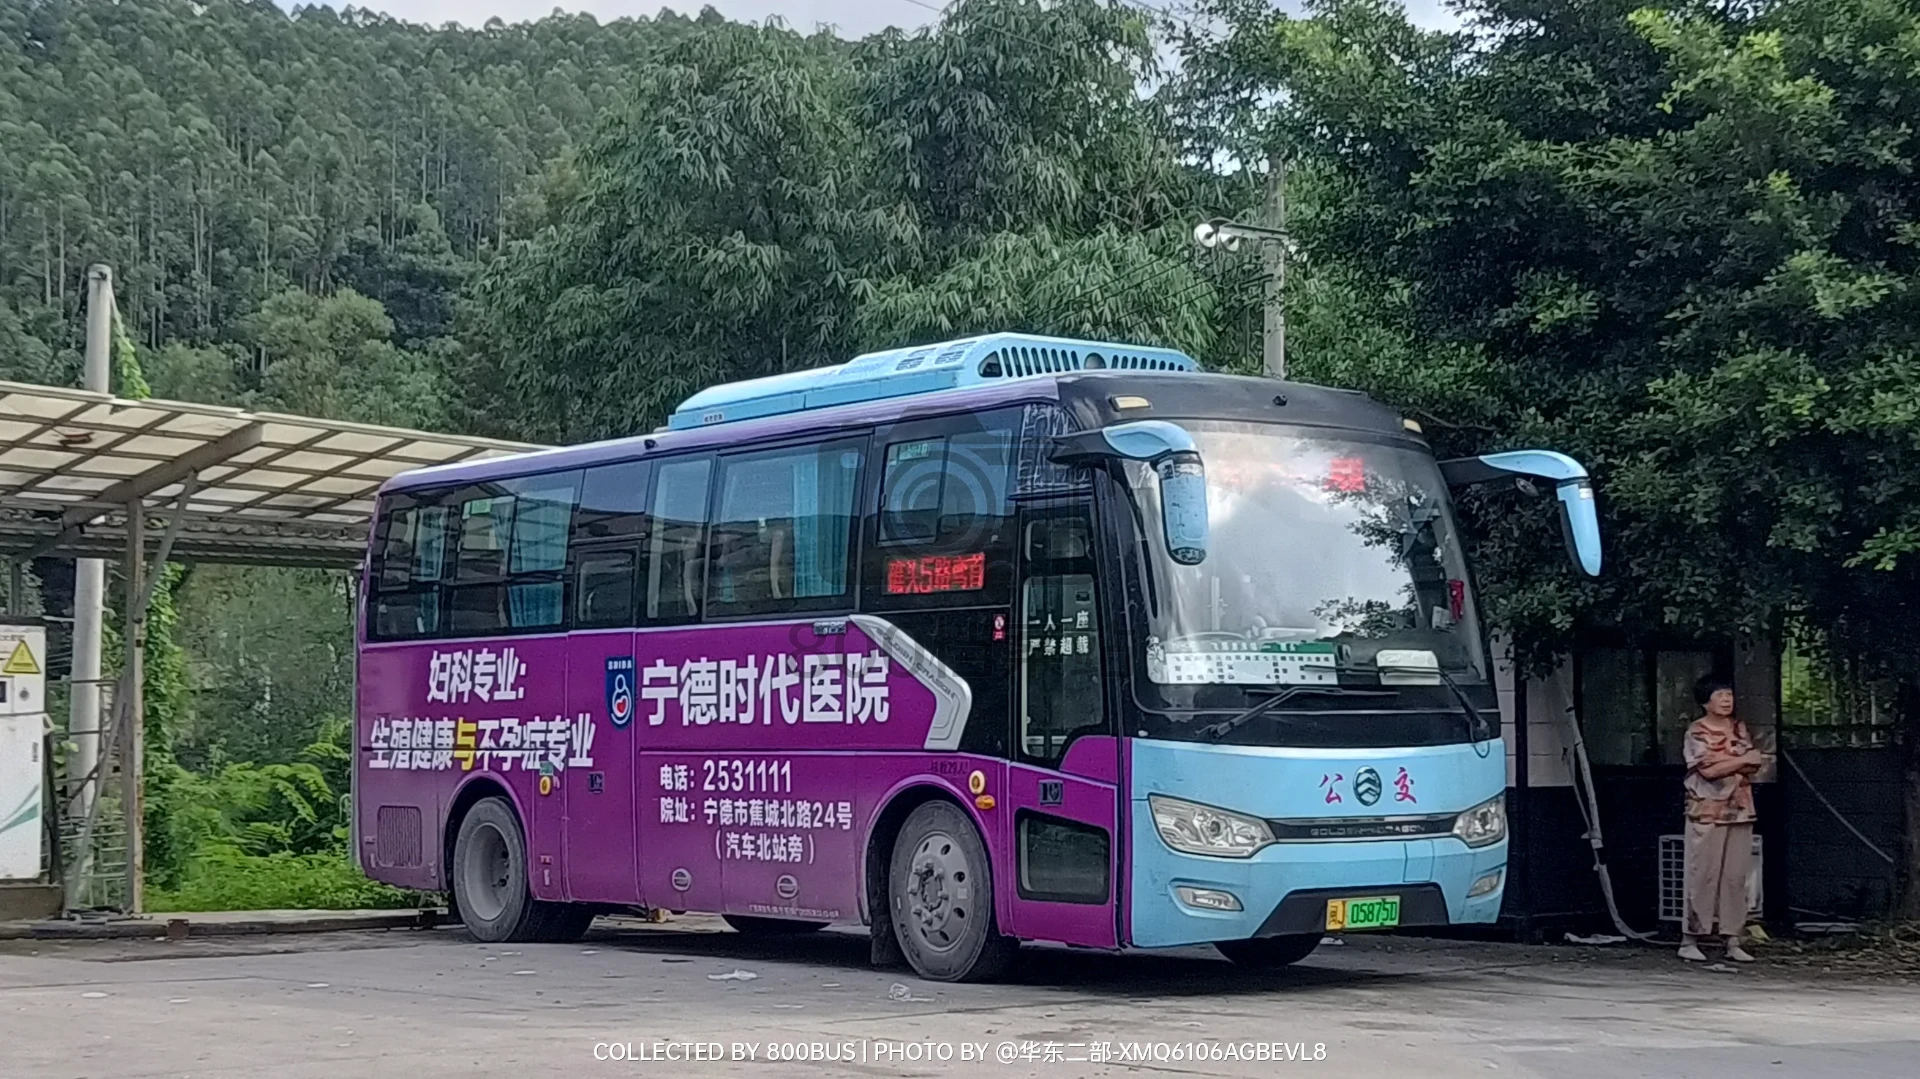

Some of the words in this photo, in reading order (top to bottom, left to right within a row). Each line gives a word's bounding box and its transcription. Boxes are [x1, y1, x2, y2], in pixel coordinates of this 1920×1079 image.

[1028, 610, 1089, 632] 一人一座
[641, 650, 889, 726] 宁德时代医院
[368, 712, 596, 773] 生殖健康与不孕症专业
[1318, 773, 1344, 805] 公
[1393, 766, 1418, 805] 交
